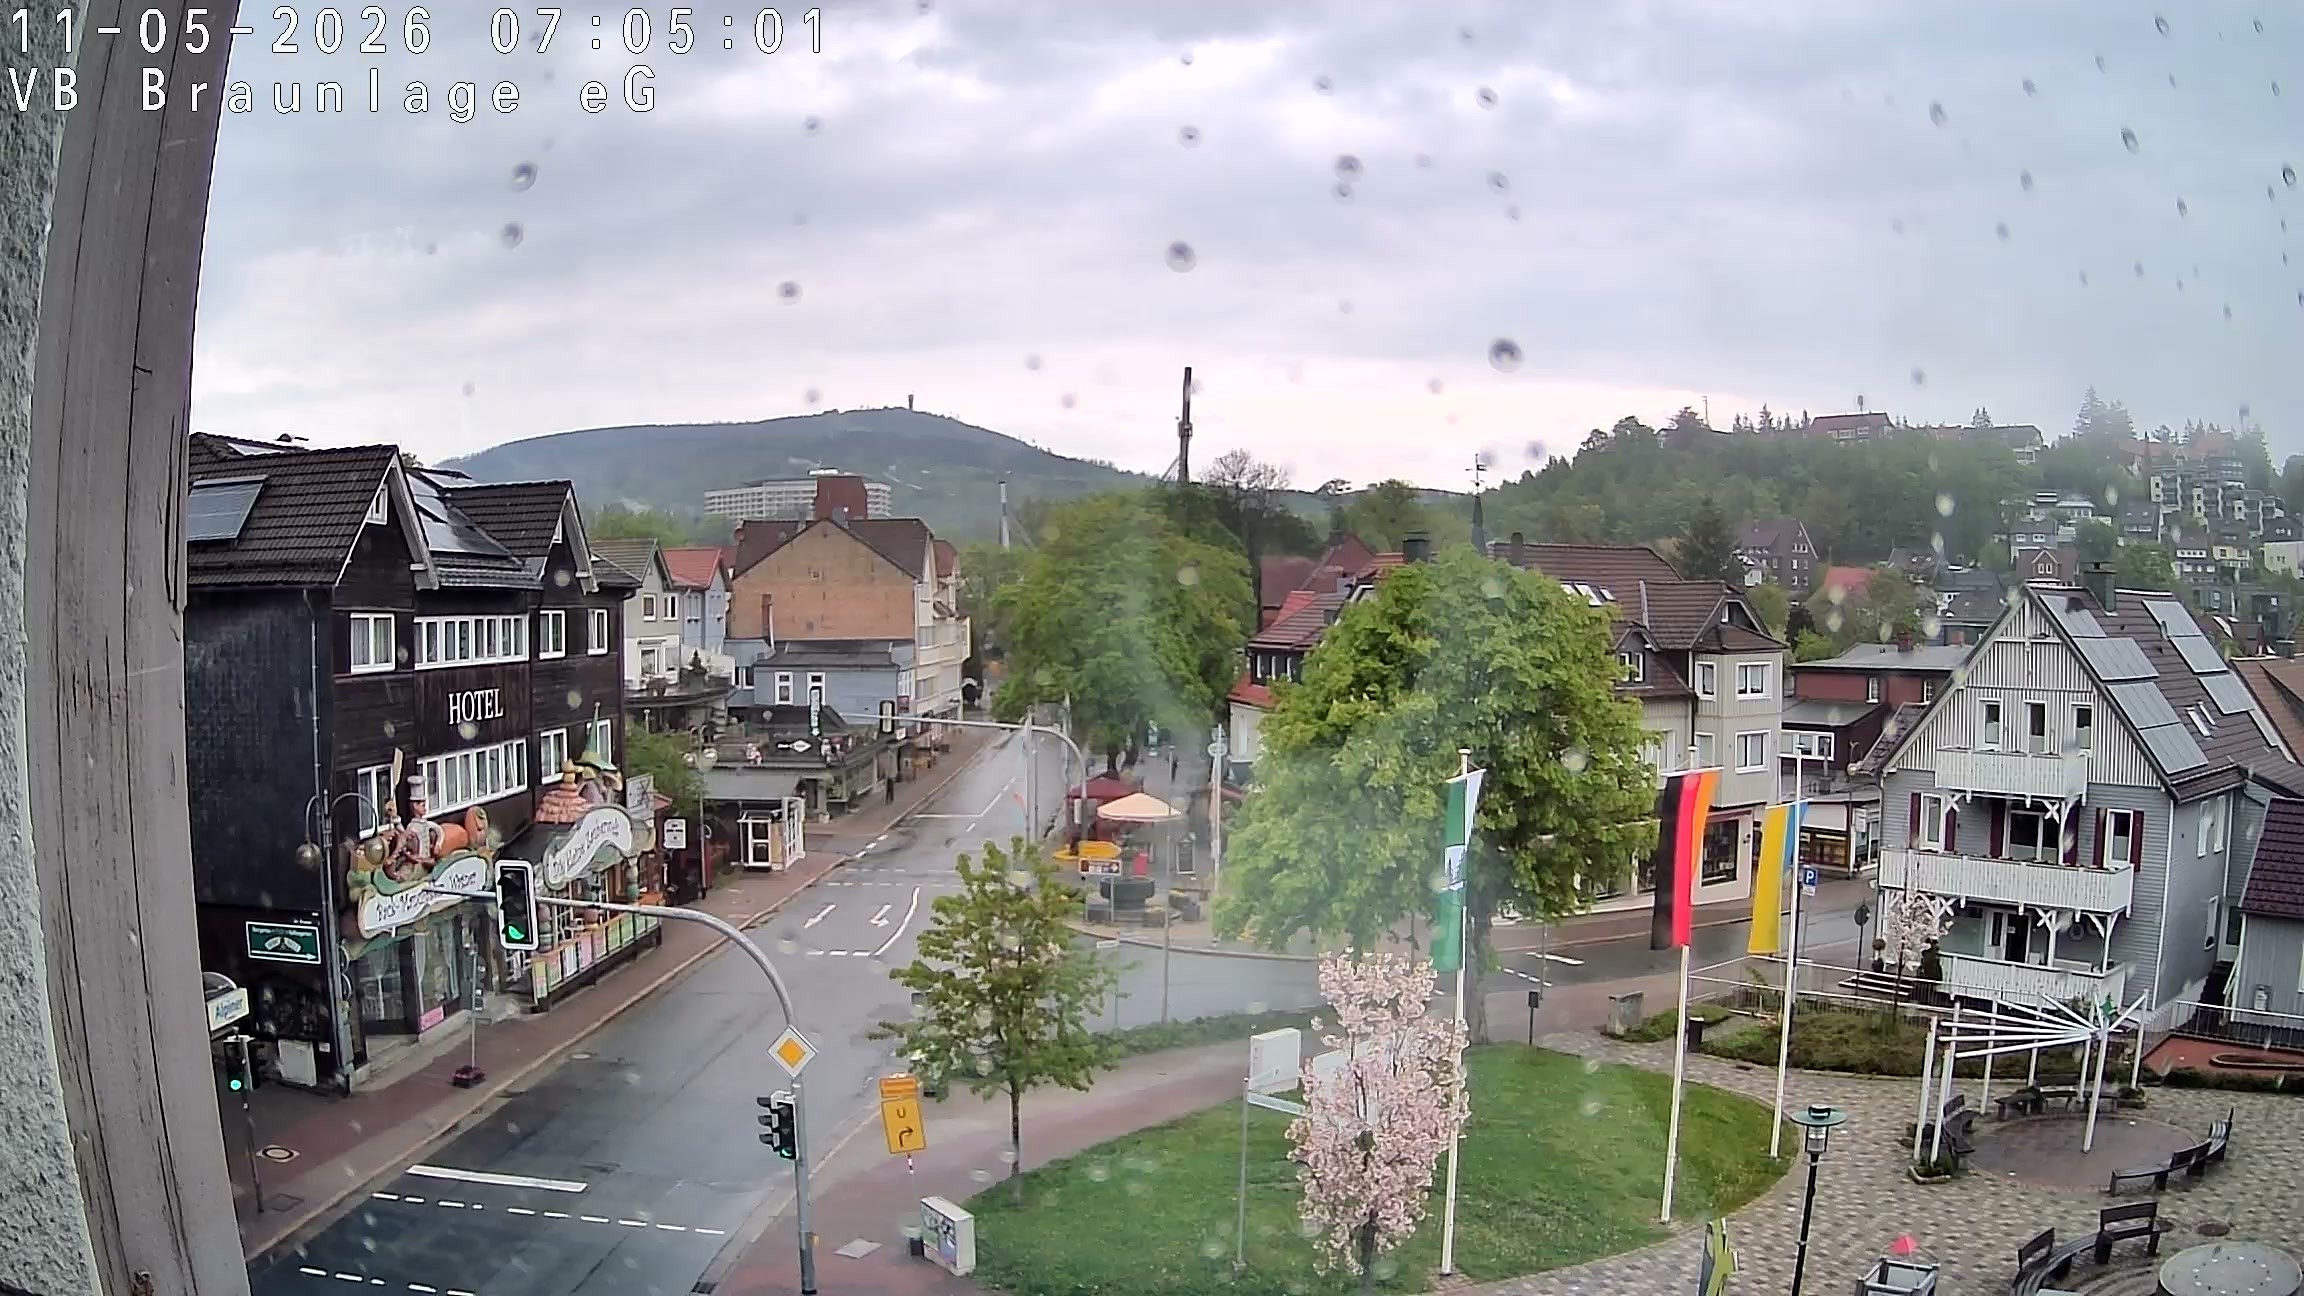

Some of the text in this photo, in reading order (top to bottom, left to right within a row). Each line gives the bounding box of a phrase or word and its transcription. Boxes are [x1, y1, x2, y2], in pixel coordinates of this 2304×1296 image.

[448, 688, 504, 725] HOTEL
[1805, 869, 1816, 884] P
[896, 1106, 906, 1119] U
